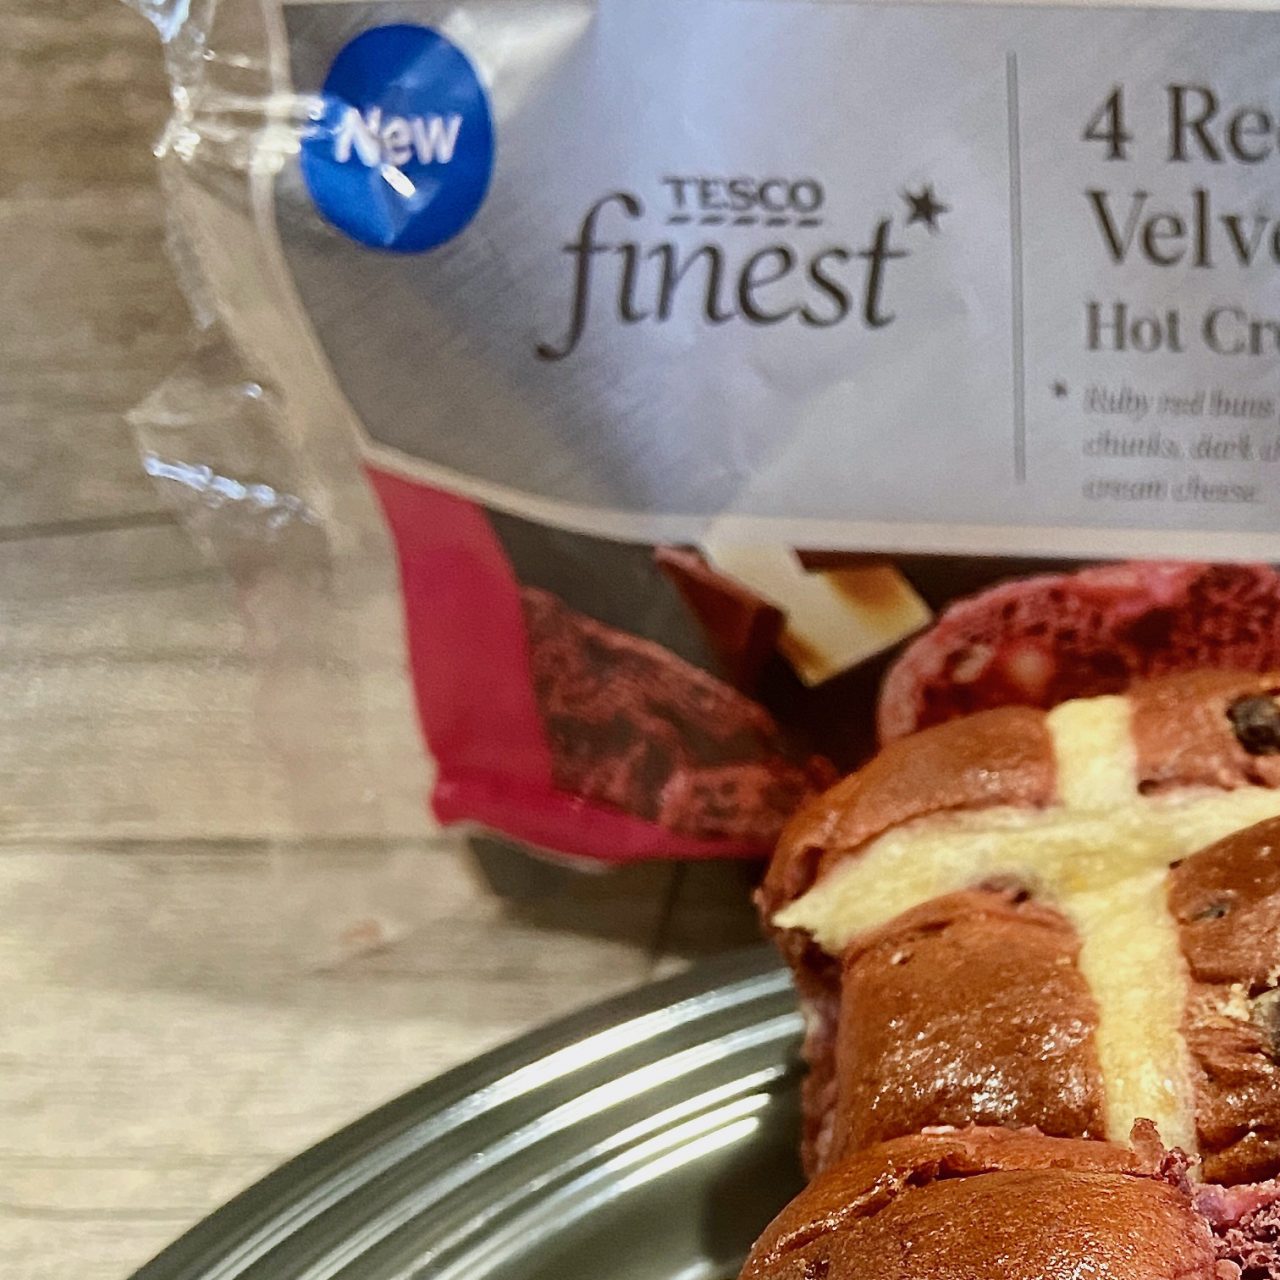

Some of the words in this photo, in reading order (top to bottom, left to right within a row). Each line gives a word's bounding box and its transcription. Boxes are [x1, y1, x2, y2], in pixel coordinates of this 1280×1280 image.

[332, 106, 462, 167] New
[1083, 85, 1132, 162] 4
[663, 176, 825, 213] TESCO
[536, 192, 908, 361] finest
[1084, 301, 1183, 353] Hot
